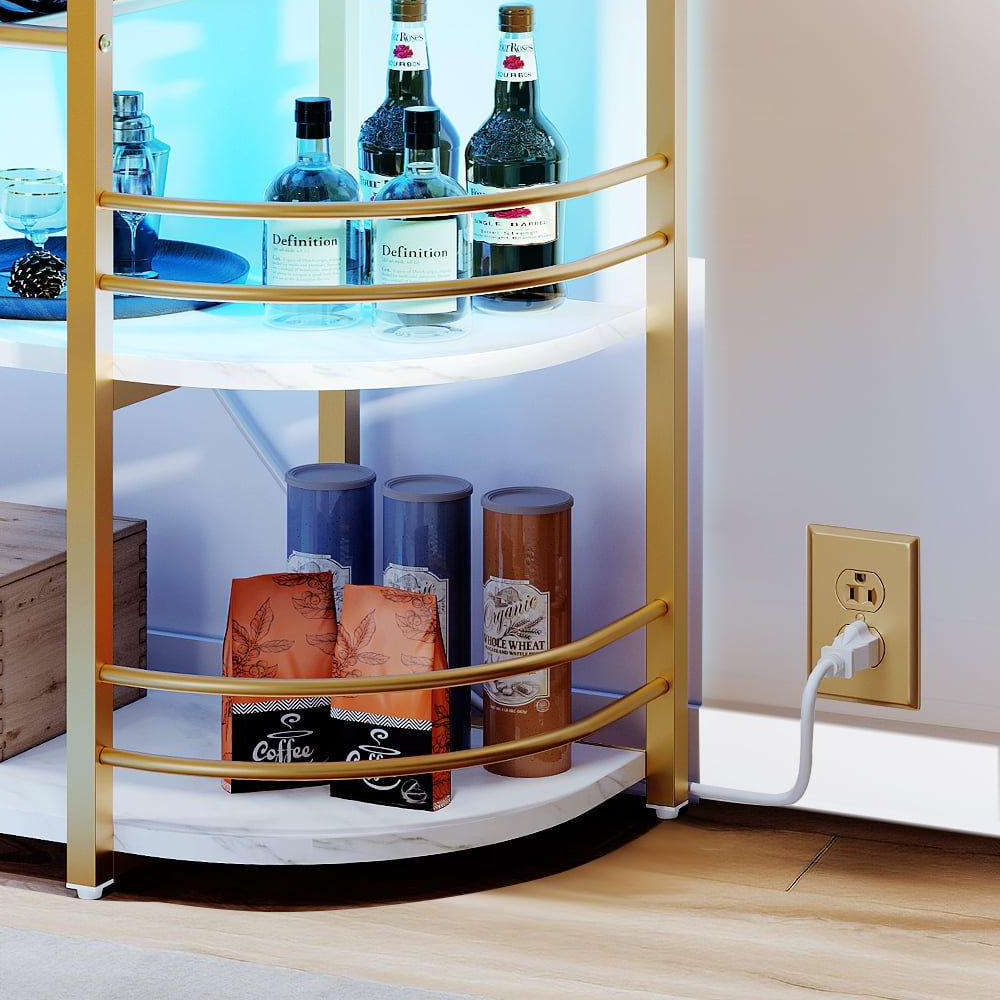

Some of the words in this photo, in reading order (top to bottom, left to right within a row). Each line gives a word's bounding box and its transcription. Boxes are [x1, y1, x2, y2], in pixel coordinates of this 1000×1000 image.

[272, 233, 337, 247] Definition
[382, 244, 448, 258] Definition
[484, 595, 537, 633] Organic
[508, 640, 545, 651] WHEAT
[252, 737, 314, 763] Coffee
